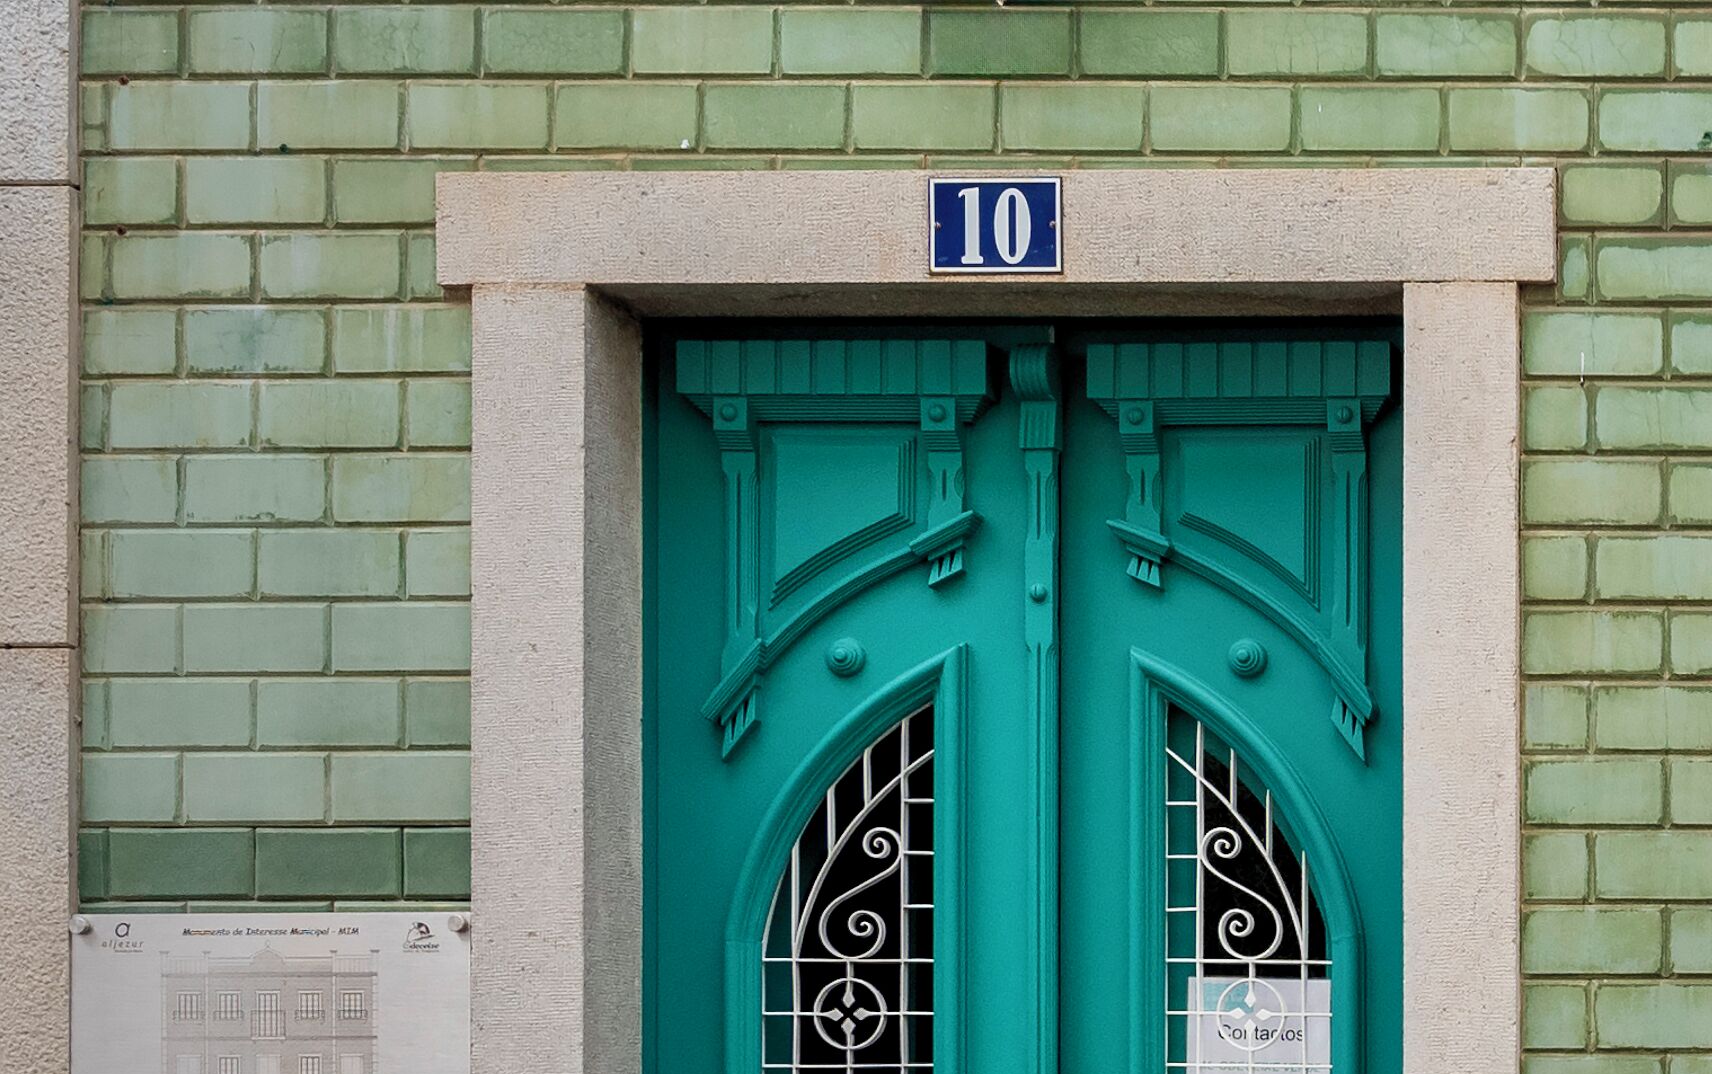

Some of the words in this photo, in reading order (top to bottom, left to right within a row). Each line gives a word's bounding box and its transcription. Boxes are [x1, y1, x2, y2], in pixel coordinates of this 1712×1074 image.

[958, 187, 1031, 265] 10
[233, 927, 243, 936] de
[245, 927, 287, 936] Interesse
